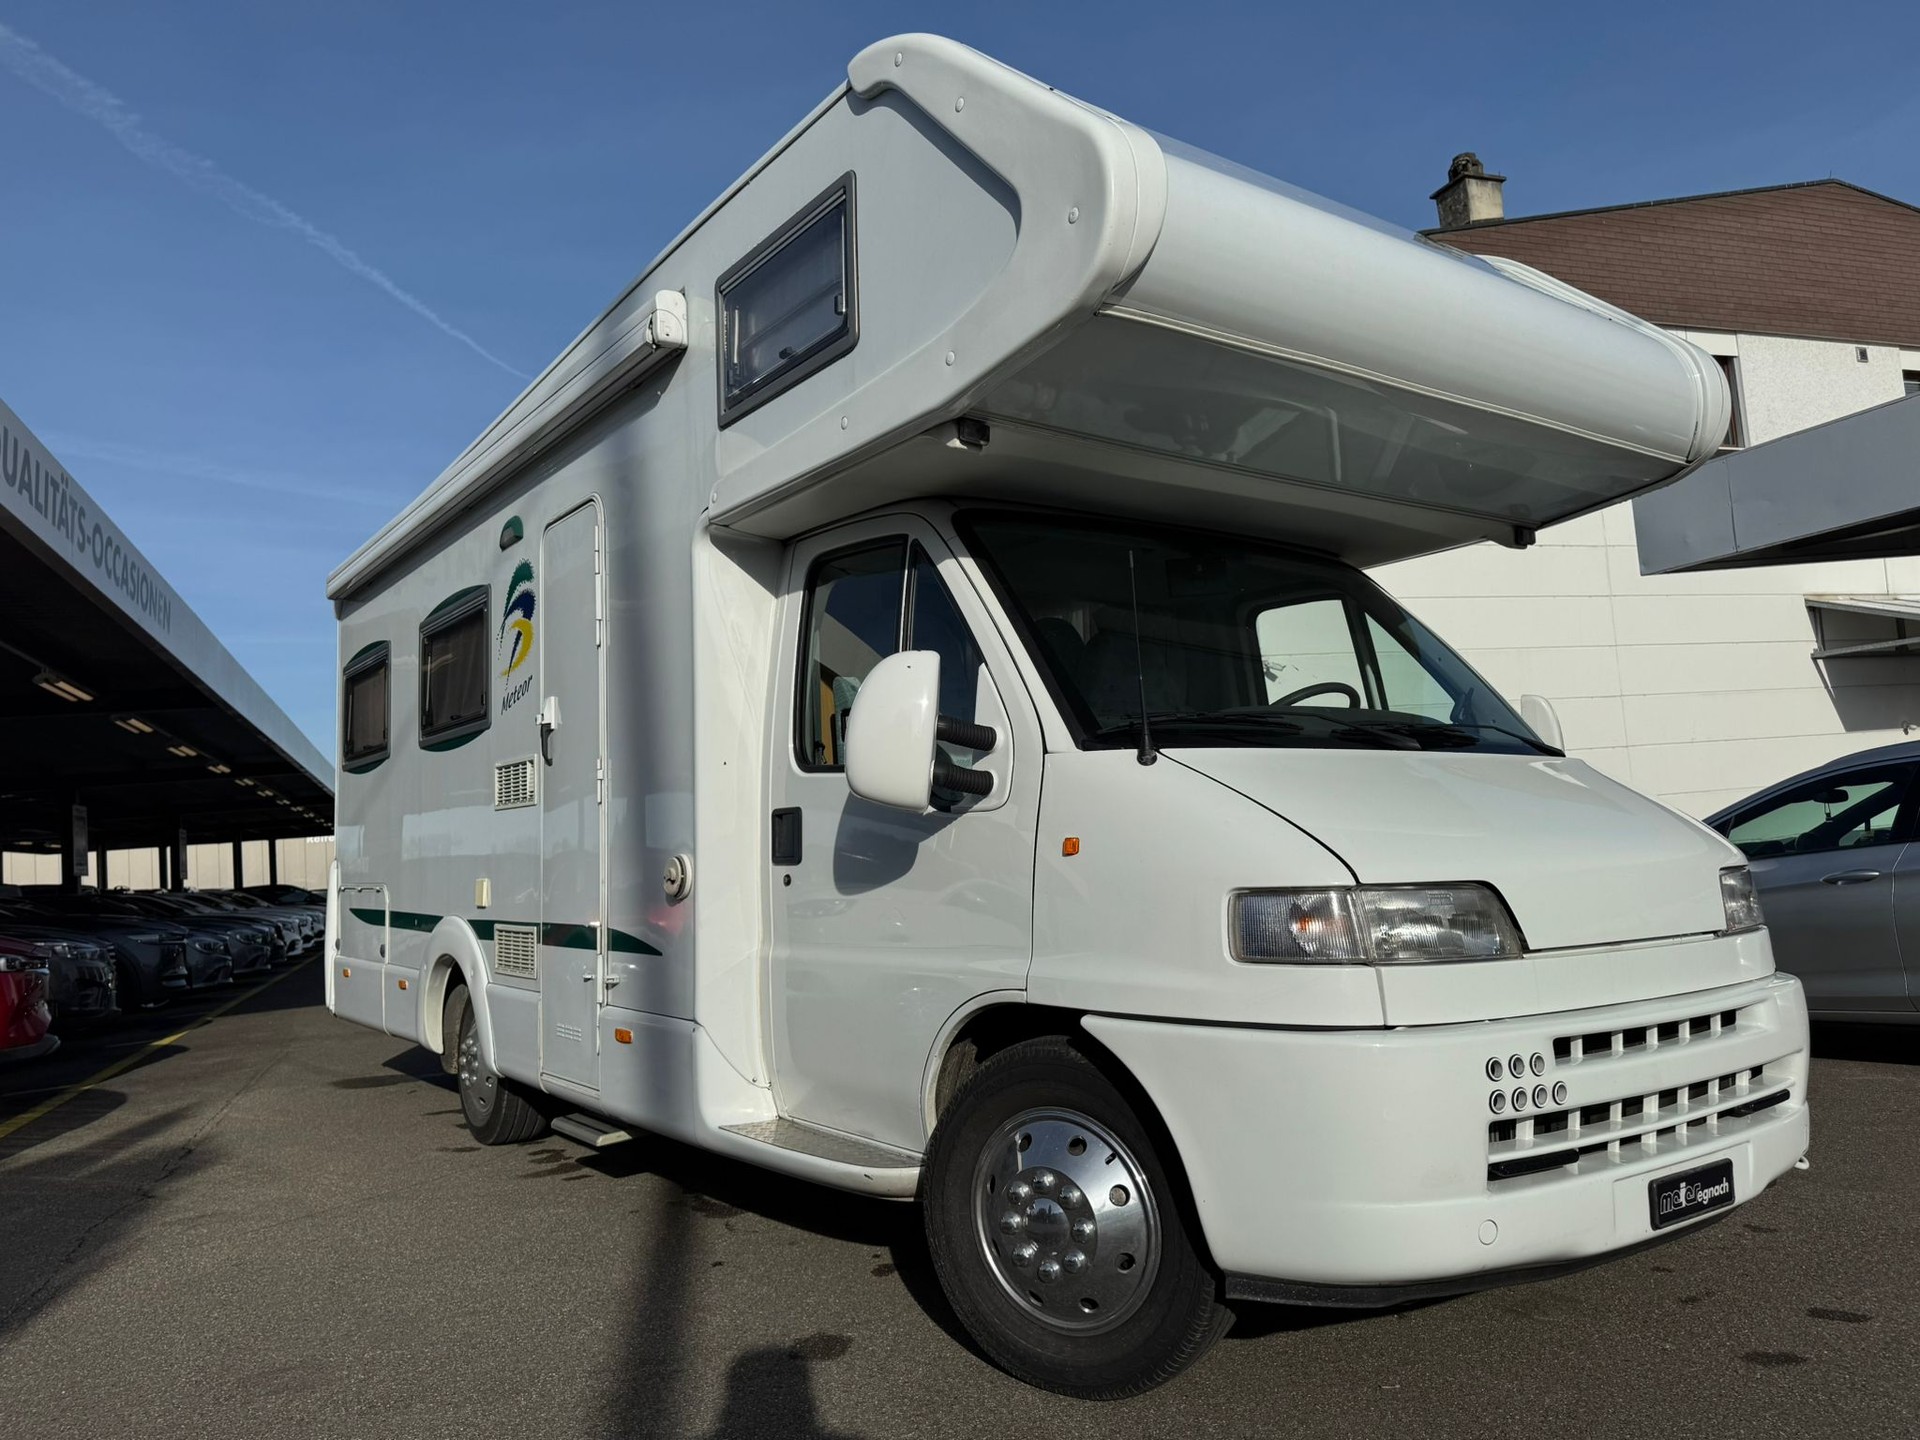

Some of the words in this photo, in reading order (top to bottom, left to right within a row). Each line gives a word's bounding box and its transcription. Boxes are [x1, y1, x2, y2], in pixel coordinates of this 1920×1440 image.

[0, 425, 171, 633] UALITÄTS-OCCASIONEN
[501, 675, 533, 715] Meteor
[1697, 1177, 1729, 1204] egnach
